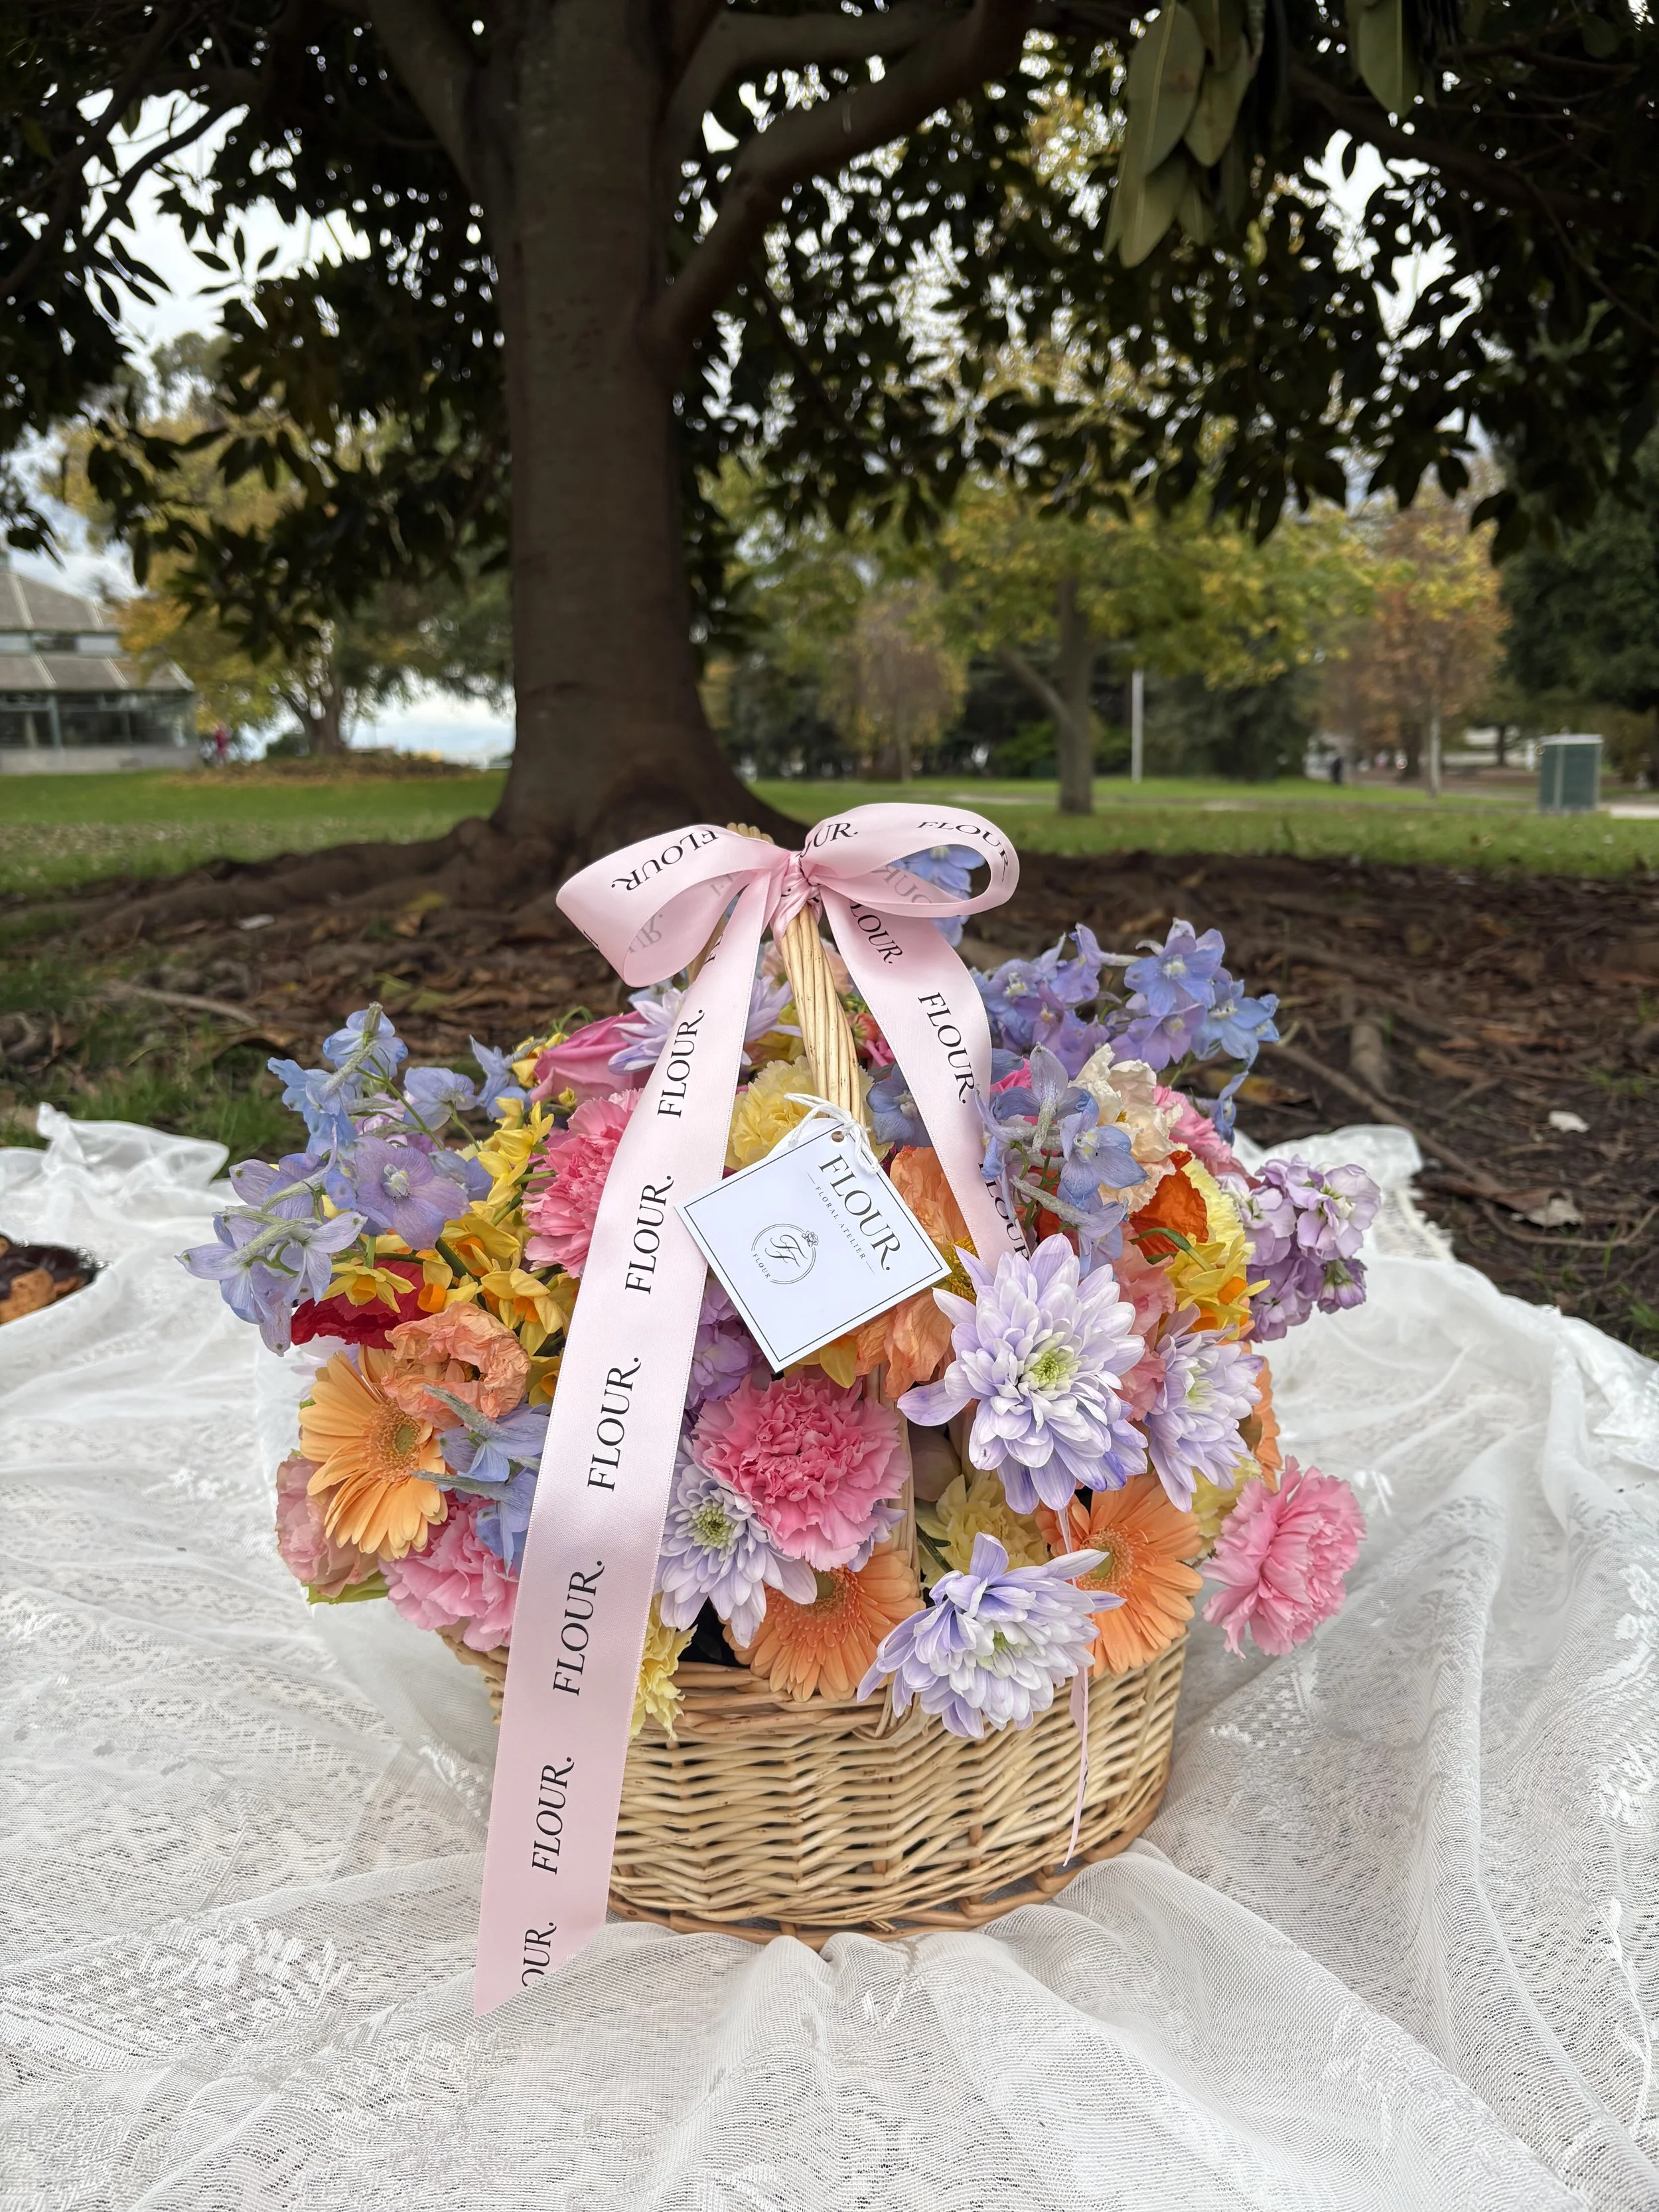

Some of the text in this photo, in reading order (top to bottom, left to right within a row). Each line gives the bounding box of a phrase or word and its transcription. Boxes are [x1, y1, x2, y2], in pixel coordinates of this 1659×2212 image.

[611, 830, 719, 891] FLOUR.
[658, 1009, 705, 1119] FLOUR.
[918, 992, 977, 1104] FLOUR.
[624, 1175, 674, 1295] FLOUR.
[753, 1253, 771, 1278] FLOUR
[815, 1186, 866, 1260] FLORAL ATELIER
[818, 1153, 902, 1271] FLOUR.
[588, 1356, 640, 1493] FLOUR.
[552, 1560, 605, 1698] FLOUR.
[532, 1757, 575, 1877] FLOUR.
